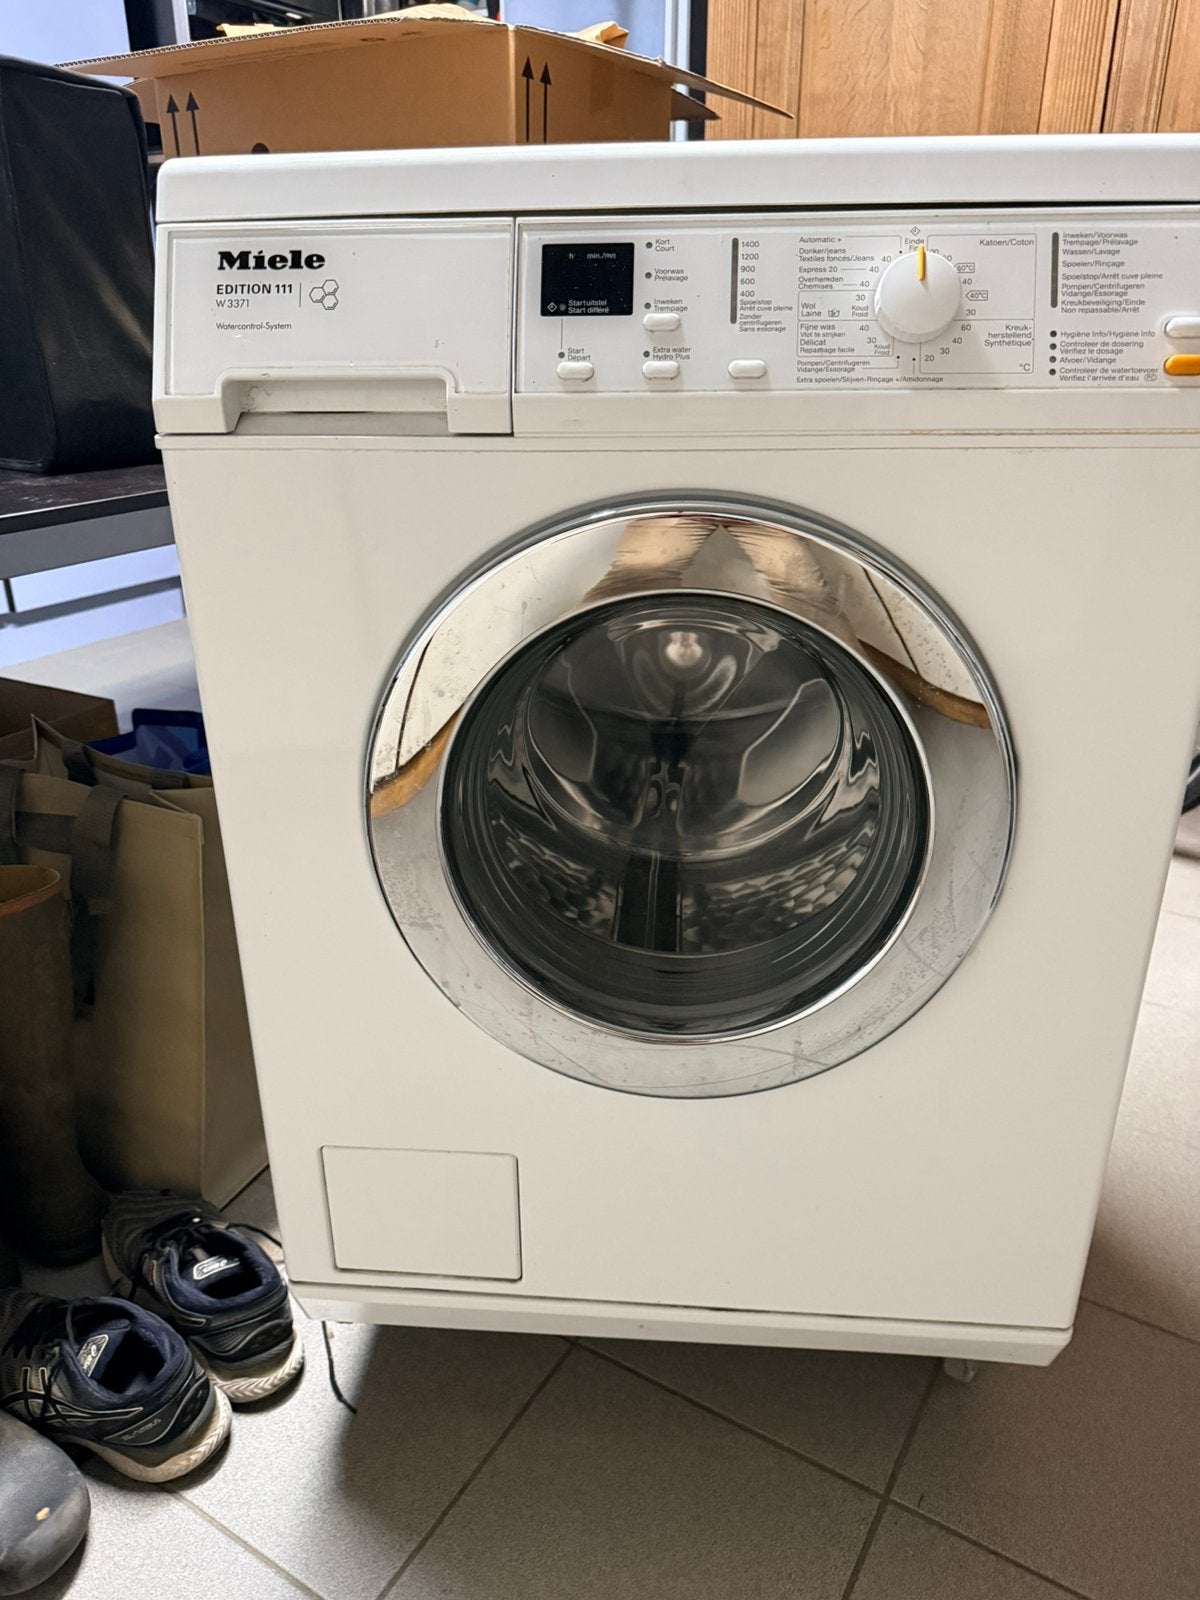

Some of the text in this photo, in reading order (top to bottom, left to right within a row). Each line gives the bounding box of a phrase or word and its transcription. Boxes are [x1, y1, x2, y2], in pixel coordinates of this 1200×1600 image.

[799, 247, 847, 256] Donker/jeans
[1062, 248, 1120, 256] Wassen/Lavage
[217, 250, 325, 270] Miele
[1062, 260, 1125, 268] Spoelen/Rinçage
[799, 266, 827, 274] Express
[654, 274, 688, 282] Prélavage
[1062, 272, 1119, 280] Spoelstop/Arrêt
[216, 283, 293, 294] EDITION 111
[568, 306, 609, 314] Start différé
[216, 321, 292, 331] Watercontrol-System
[800, 323, 818, 331] Fijne
[821, 331, 846, 339] strijken
[984, 339, 1032, 347] Synthétique
[940, 347, 950, 355] 30
[567, 353, 591, 361] Départ
[652, 353, 673, 361] Hydro
[924, 354, 934, 362] 20
[1060, 356, 1117, 364] Afvoer/Vidange
